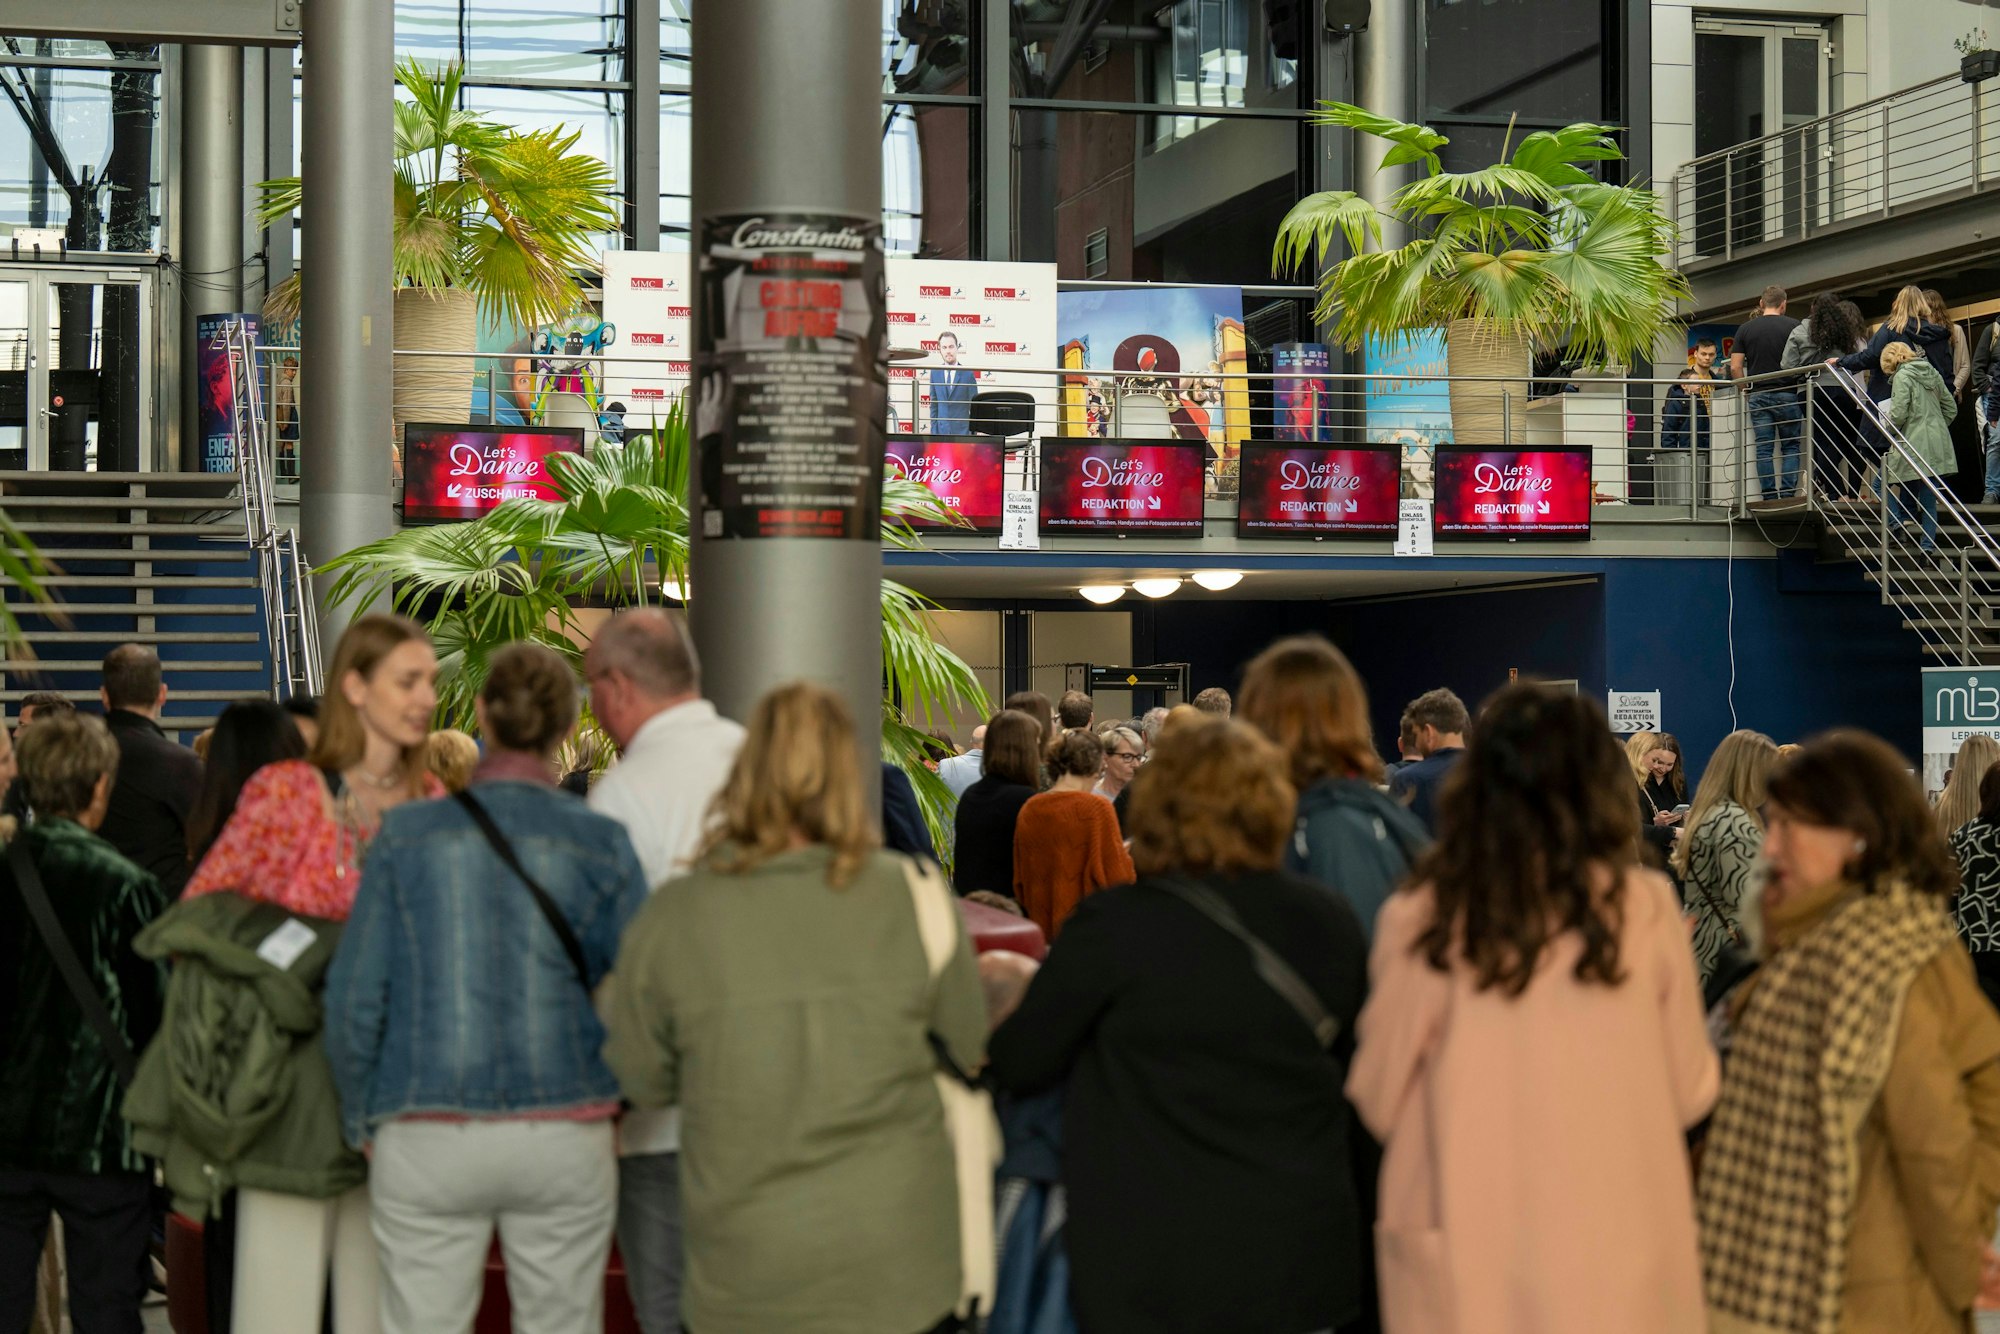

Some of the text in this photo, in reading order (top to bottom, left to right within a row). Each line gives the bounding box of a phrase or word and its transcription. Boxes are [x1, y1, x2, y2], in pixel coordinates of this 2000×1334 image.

[731, 218, 865, 249] Constantin
[632, 280, 656, 288] MMC
[921, 288, 944, 296] MMC
[985, 290, 1008, 298] MMC
[921, 343, 940, 351] MM
[483, 446, 517, 458] Let's
[450, 443, 538, 476] Dance
[909, 455, 941, 466] Let's
[1113, 458, 1143, 470] Let's
[1081, 456, 1164, 487] Dance
[1311, 462, 1341, 474] Let's
[1504, 464, 1533, 476] Let's
[1280, 460, 1360, 490] Dance
[1474, 462, 1552, 493] Dance
[465, 488, 537, 499] ZUSCHAUER
[1081, 498, 1145, 510] REDAKTION
[1280, 501, 1341, 512] REDAKTION
[1474, 503, 1534, 514] REDAKTION
